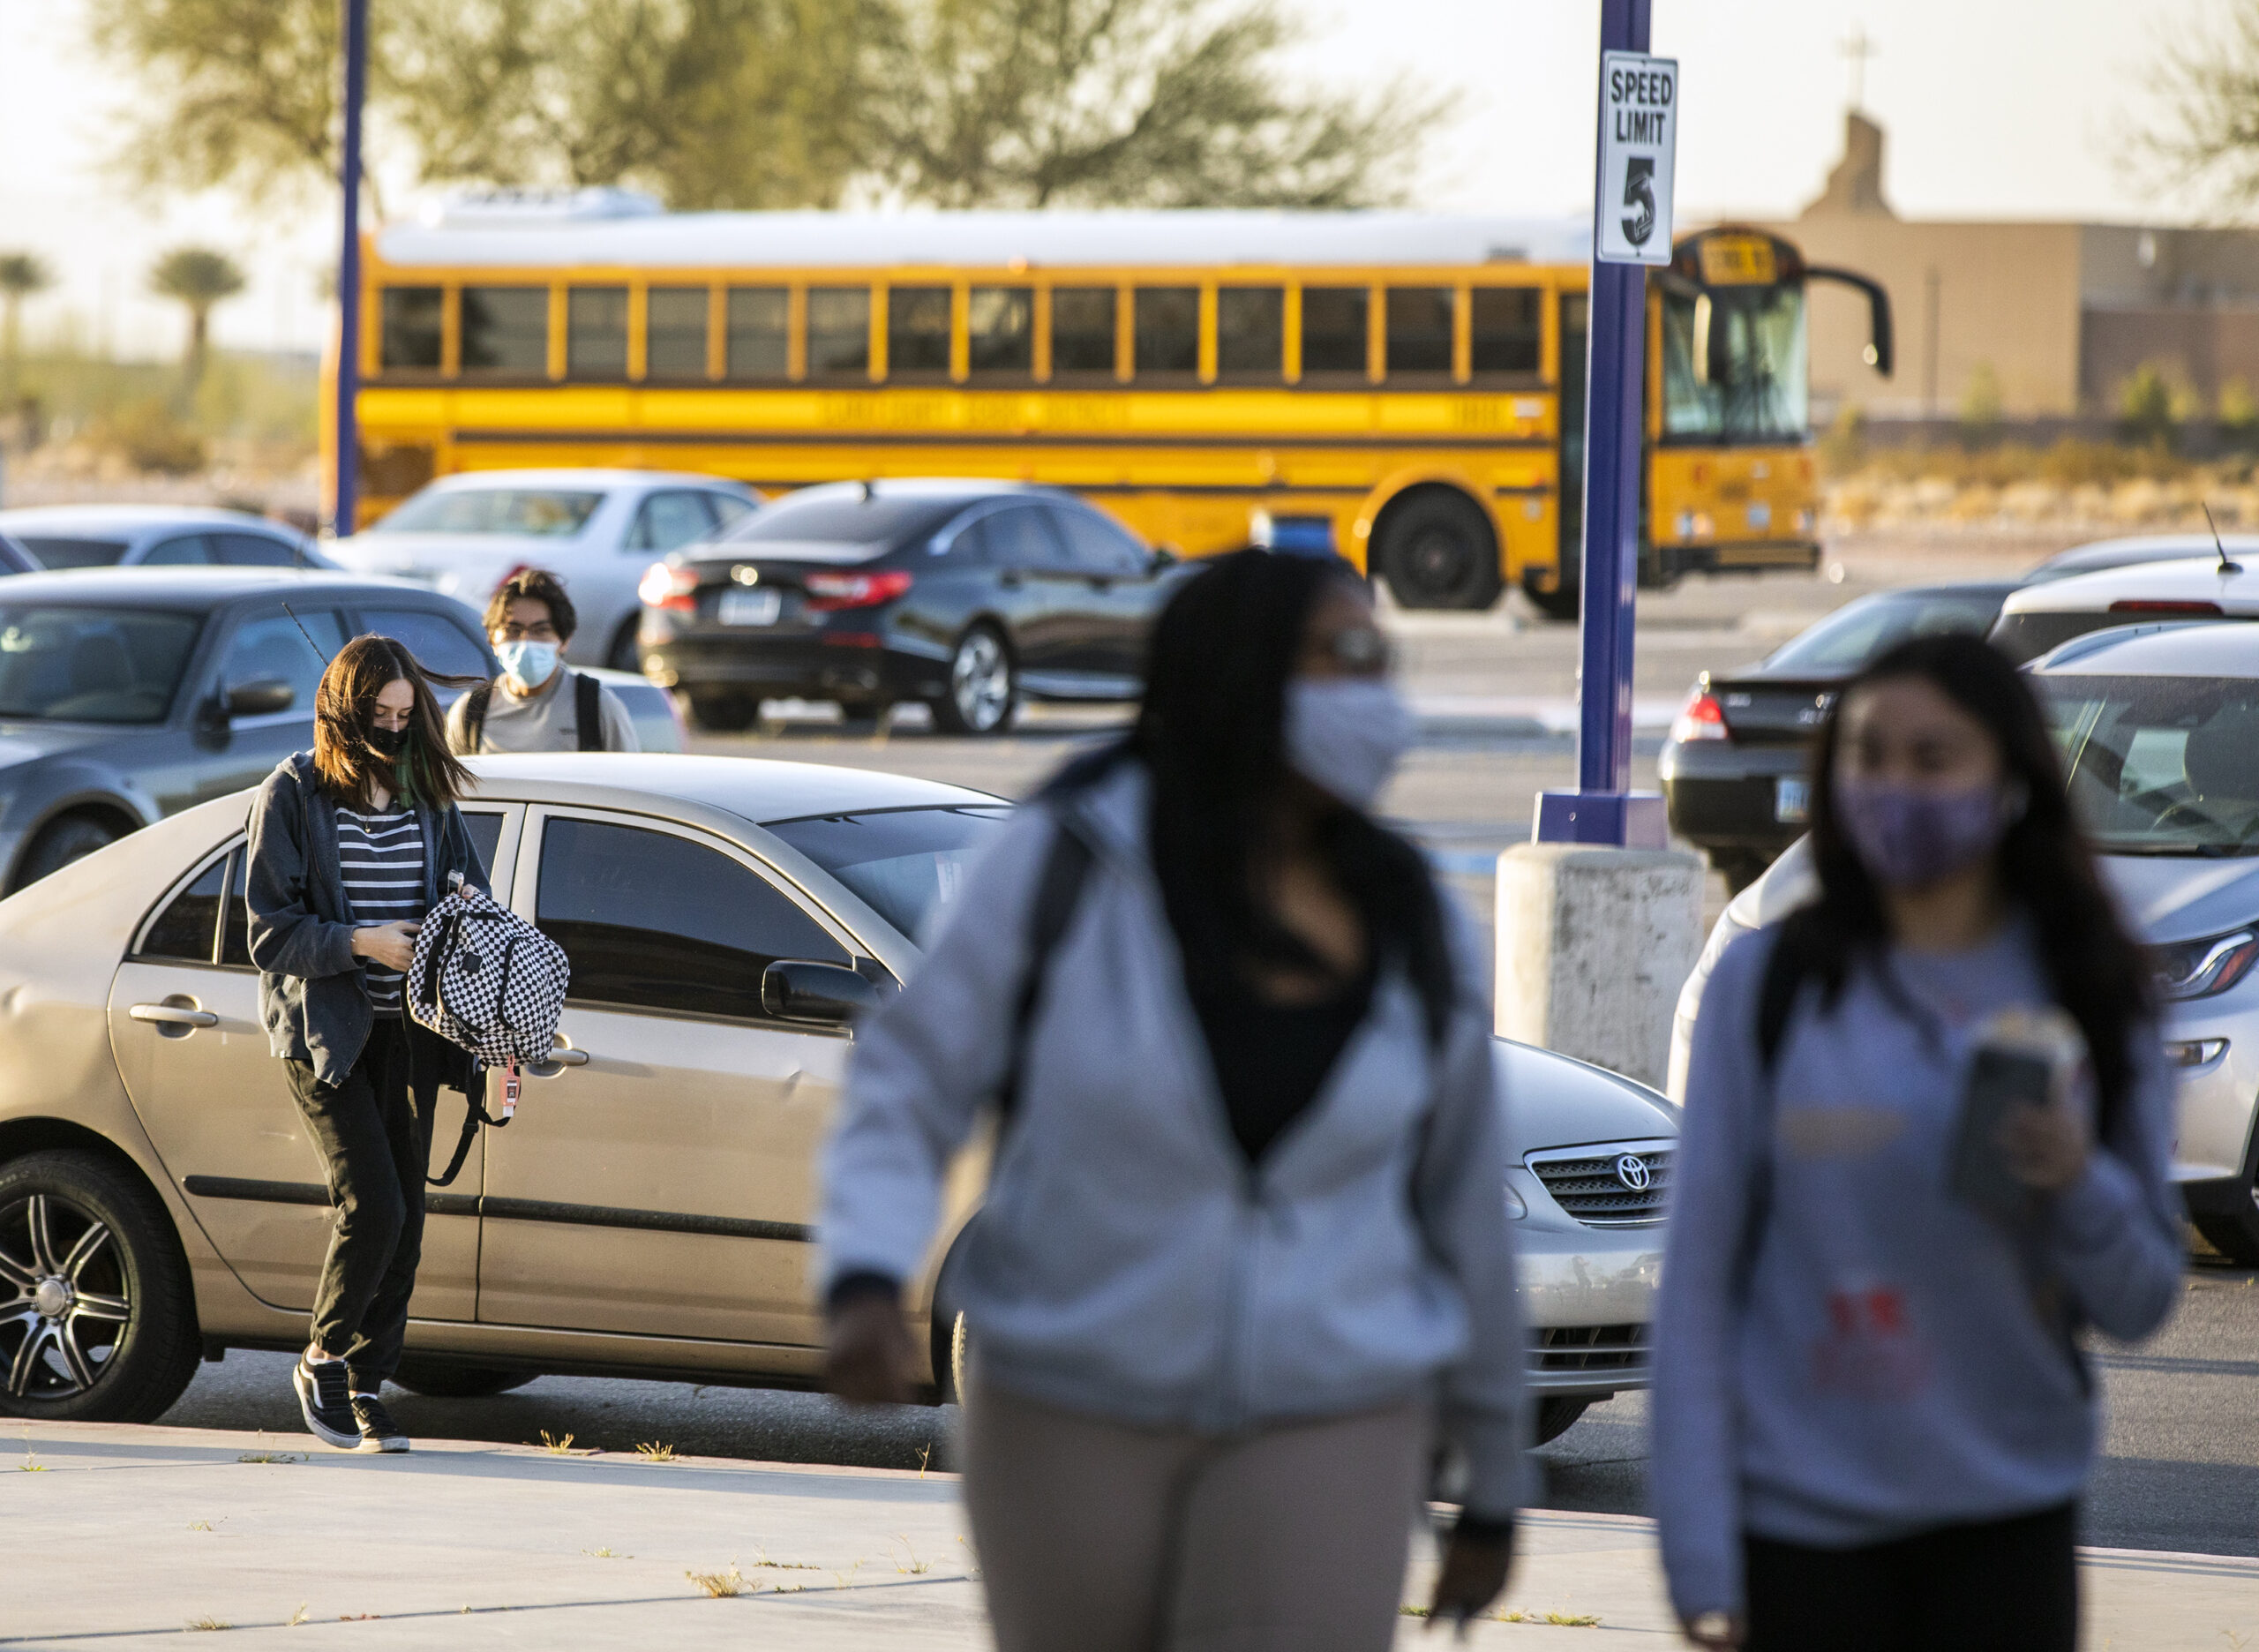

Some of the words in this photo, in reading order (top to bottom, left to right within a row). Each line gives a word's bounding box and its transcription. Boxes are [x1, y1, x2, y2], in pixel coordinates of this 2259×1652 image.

[1611, 70, 1673, 106] SPEED
[1616, 109, 1666, 146] LIMIT
[1621, 157, 1655, 246] 5
